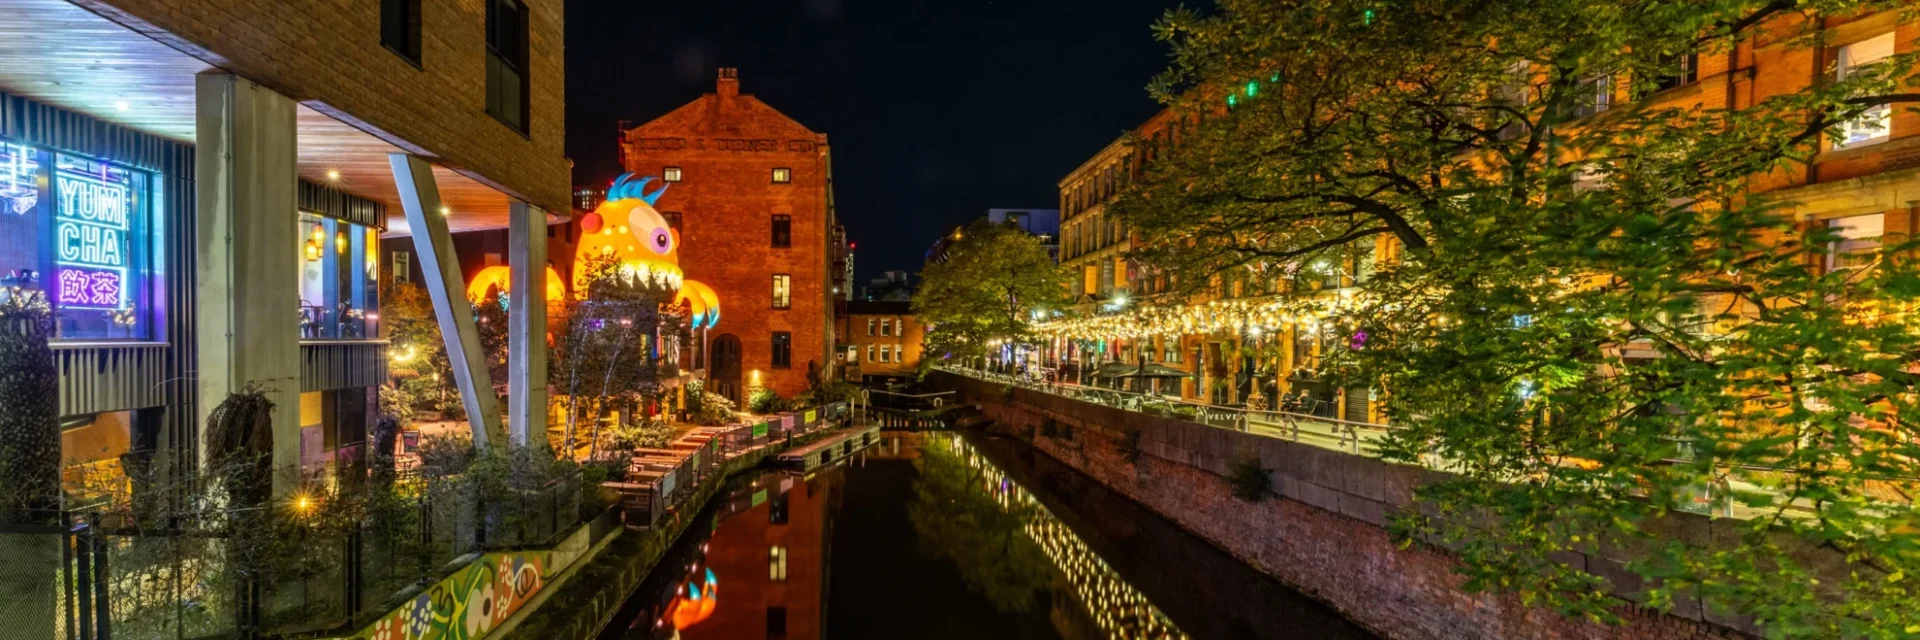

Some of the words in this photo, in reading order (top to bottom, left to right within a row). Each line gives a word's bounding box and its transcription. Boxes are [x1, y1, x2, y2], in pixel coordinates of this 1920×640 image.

[713, 138, 779, 152] TURNER
[58, 176, 121, 224] YUM
[60, 222, 121, 265] CHA
[60, 269, 119, 305] 飲茶
